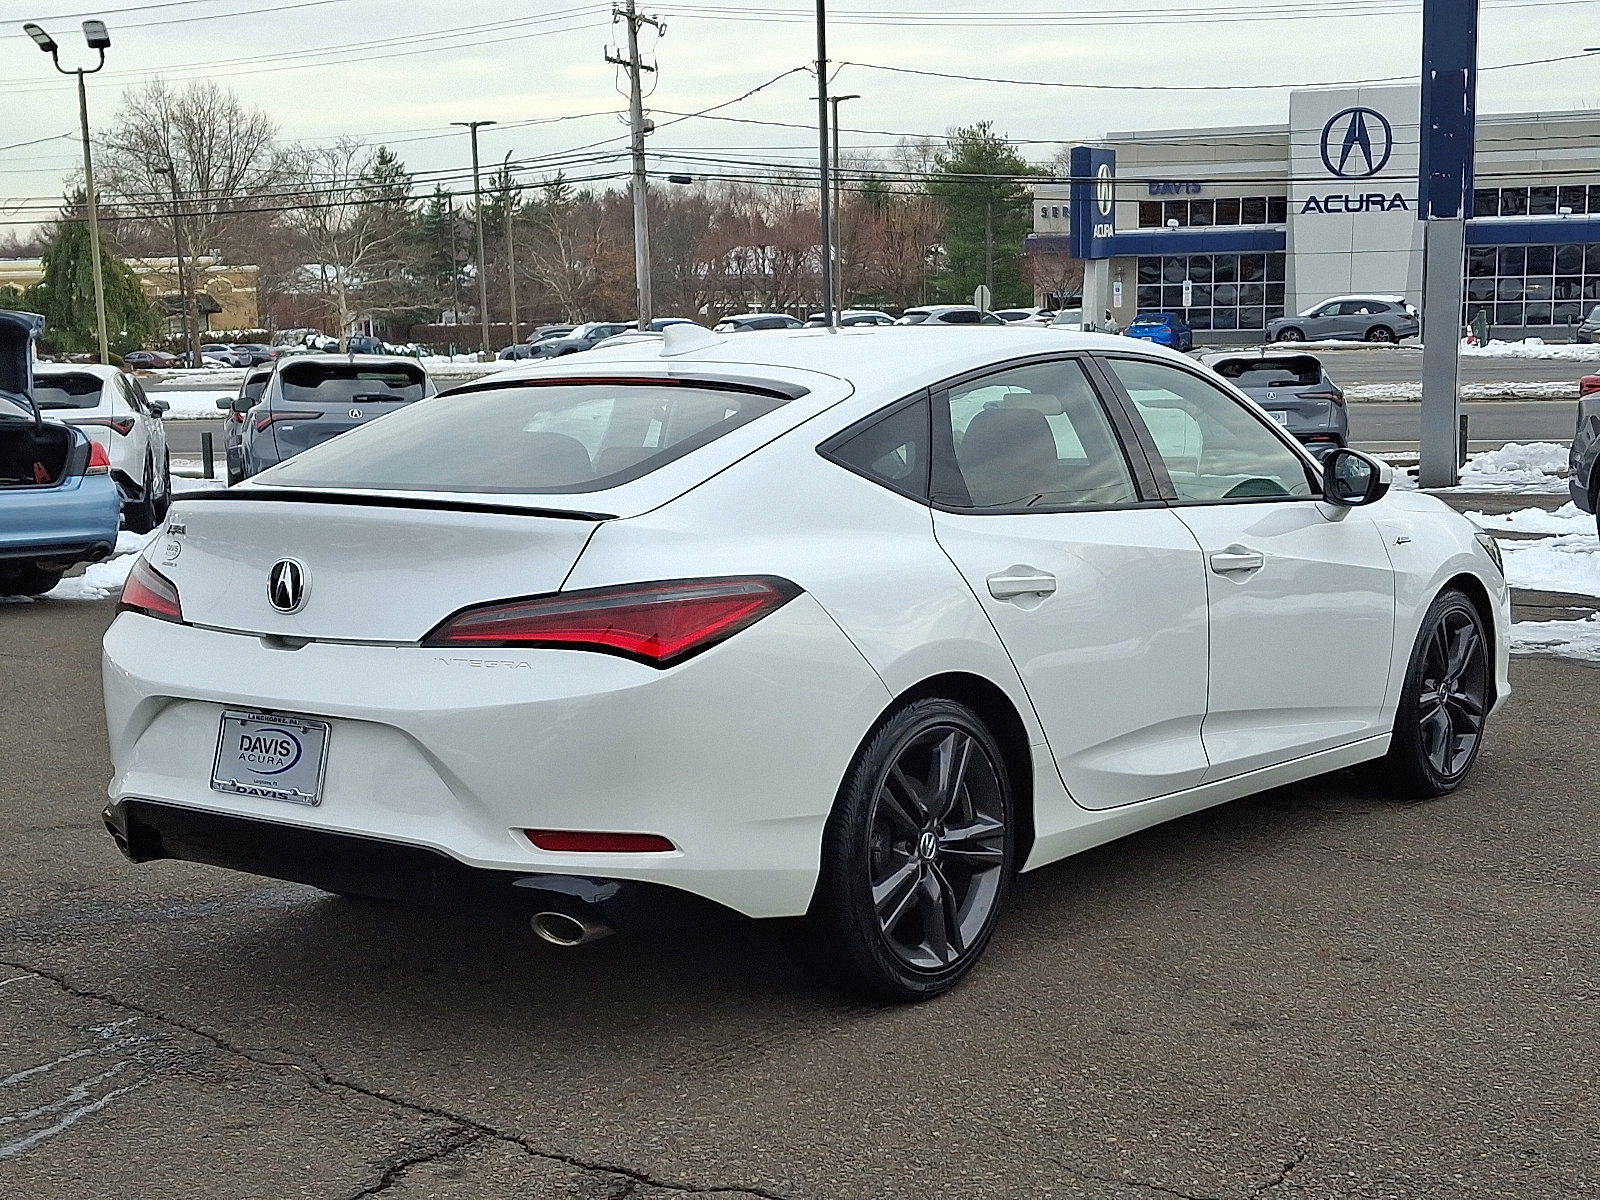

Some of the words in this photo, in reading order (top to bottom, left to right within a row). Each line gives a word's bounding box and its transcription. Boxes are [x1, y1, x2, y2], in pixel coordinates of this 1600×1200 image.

[1148, 182, 1201, 195] DAVIS
[1301, 193, 1408, 214] ACURA
[1093, 223, 1114, 238] ACURA
[433, 657, 532, 669] INTEGRA
[239, 734, 291, 757] DAVIS
[238, 752, 284, 766] ACURA
[236, 786, 289, 800] DAVIS
